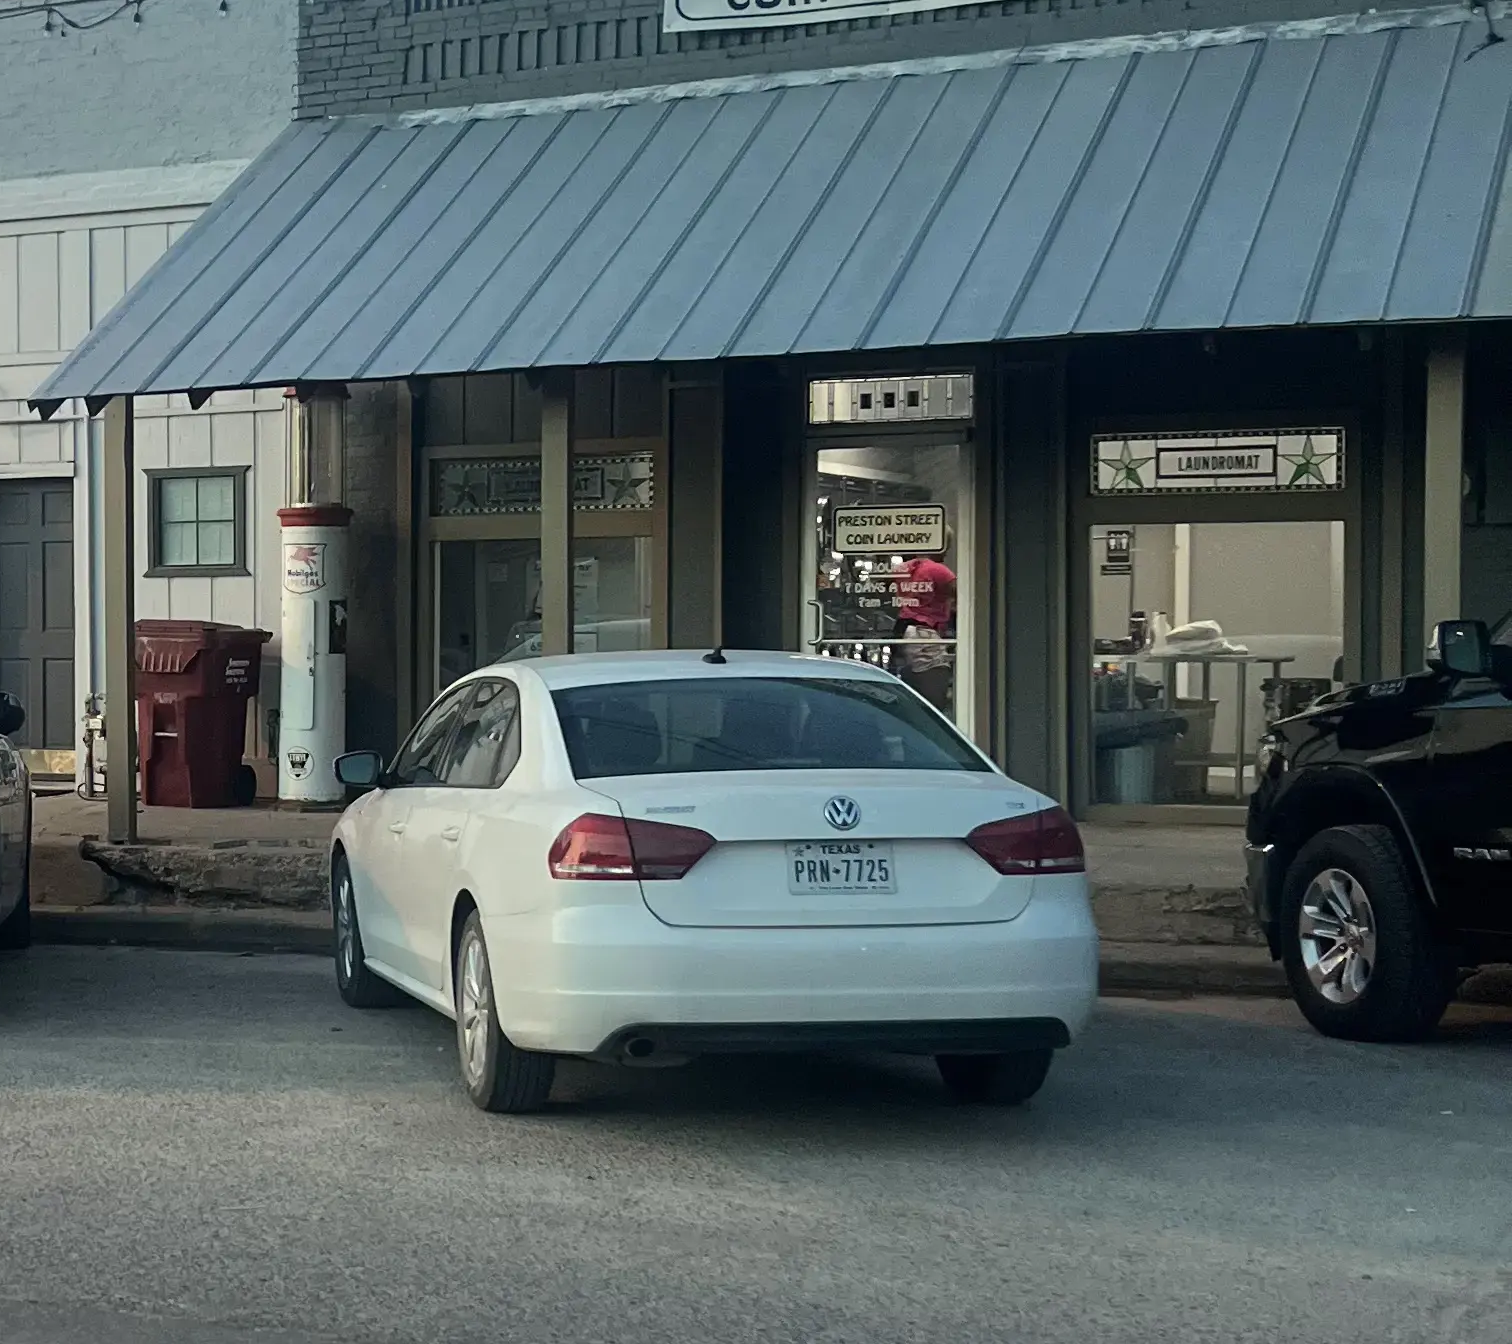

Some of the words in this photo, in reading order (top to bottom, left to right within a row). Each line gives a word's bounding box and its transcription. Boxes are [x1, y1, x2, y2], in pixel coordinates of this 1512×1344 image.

[1177, 454, 1261, 472] LAUNDROMAT
[837, 515, 892, 527] PRESTON
[895, 513, 941, 525] STREET
[846, 534, 874, 545] COIN
[877, 532, 932, 545] LAUNDRY
[854, 581, 887, 593] DAYS
[889, 582, 898, 593] A
[900, 581, 934, 593] WEEK
[820, 843, 861, 855] TEXAS
